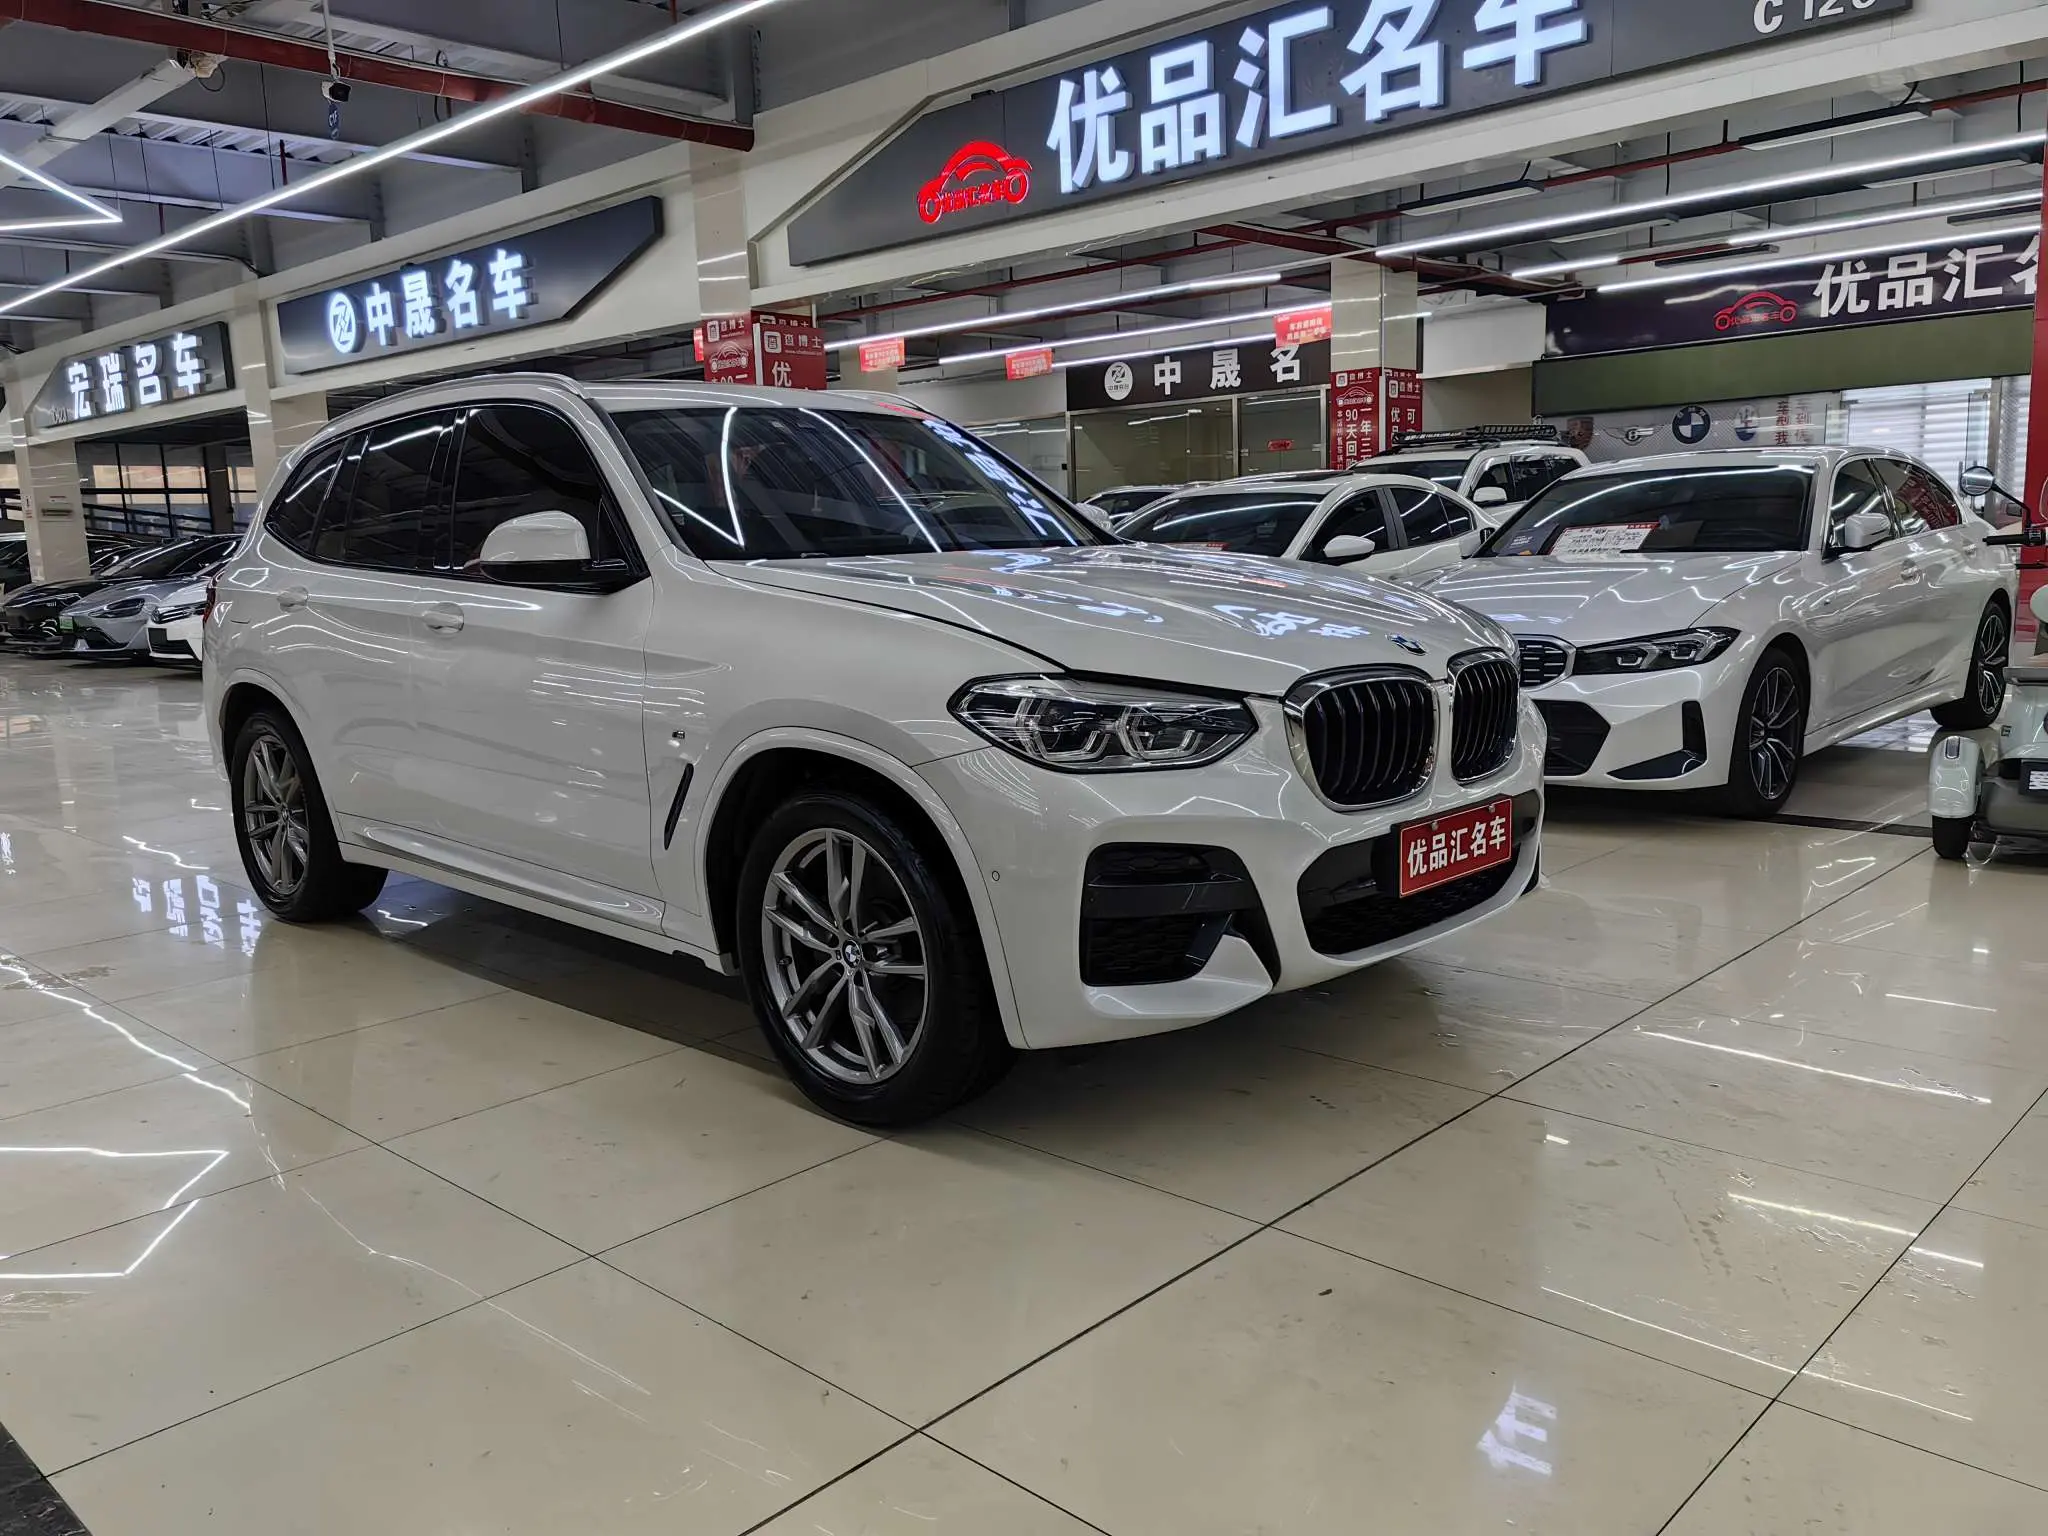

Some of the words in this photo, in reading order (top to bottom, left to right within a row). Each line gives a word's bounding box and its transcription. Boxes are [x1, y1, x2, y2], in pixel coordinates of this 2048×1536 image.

[1046, 0, 1588, 194] 优品汇名车
[366, 248, 528, 347] 中晟名车
[1407, 815, 1506, 878] 优品汇名车
